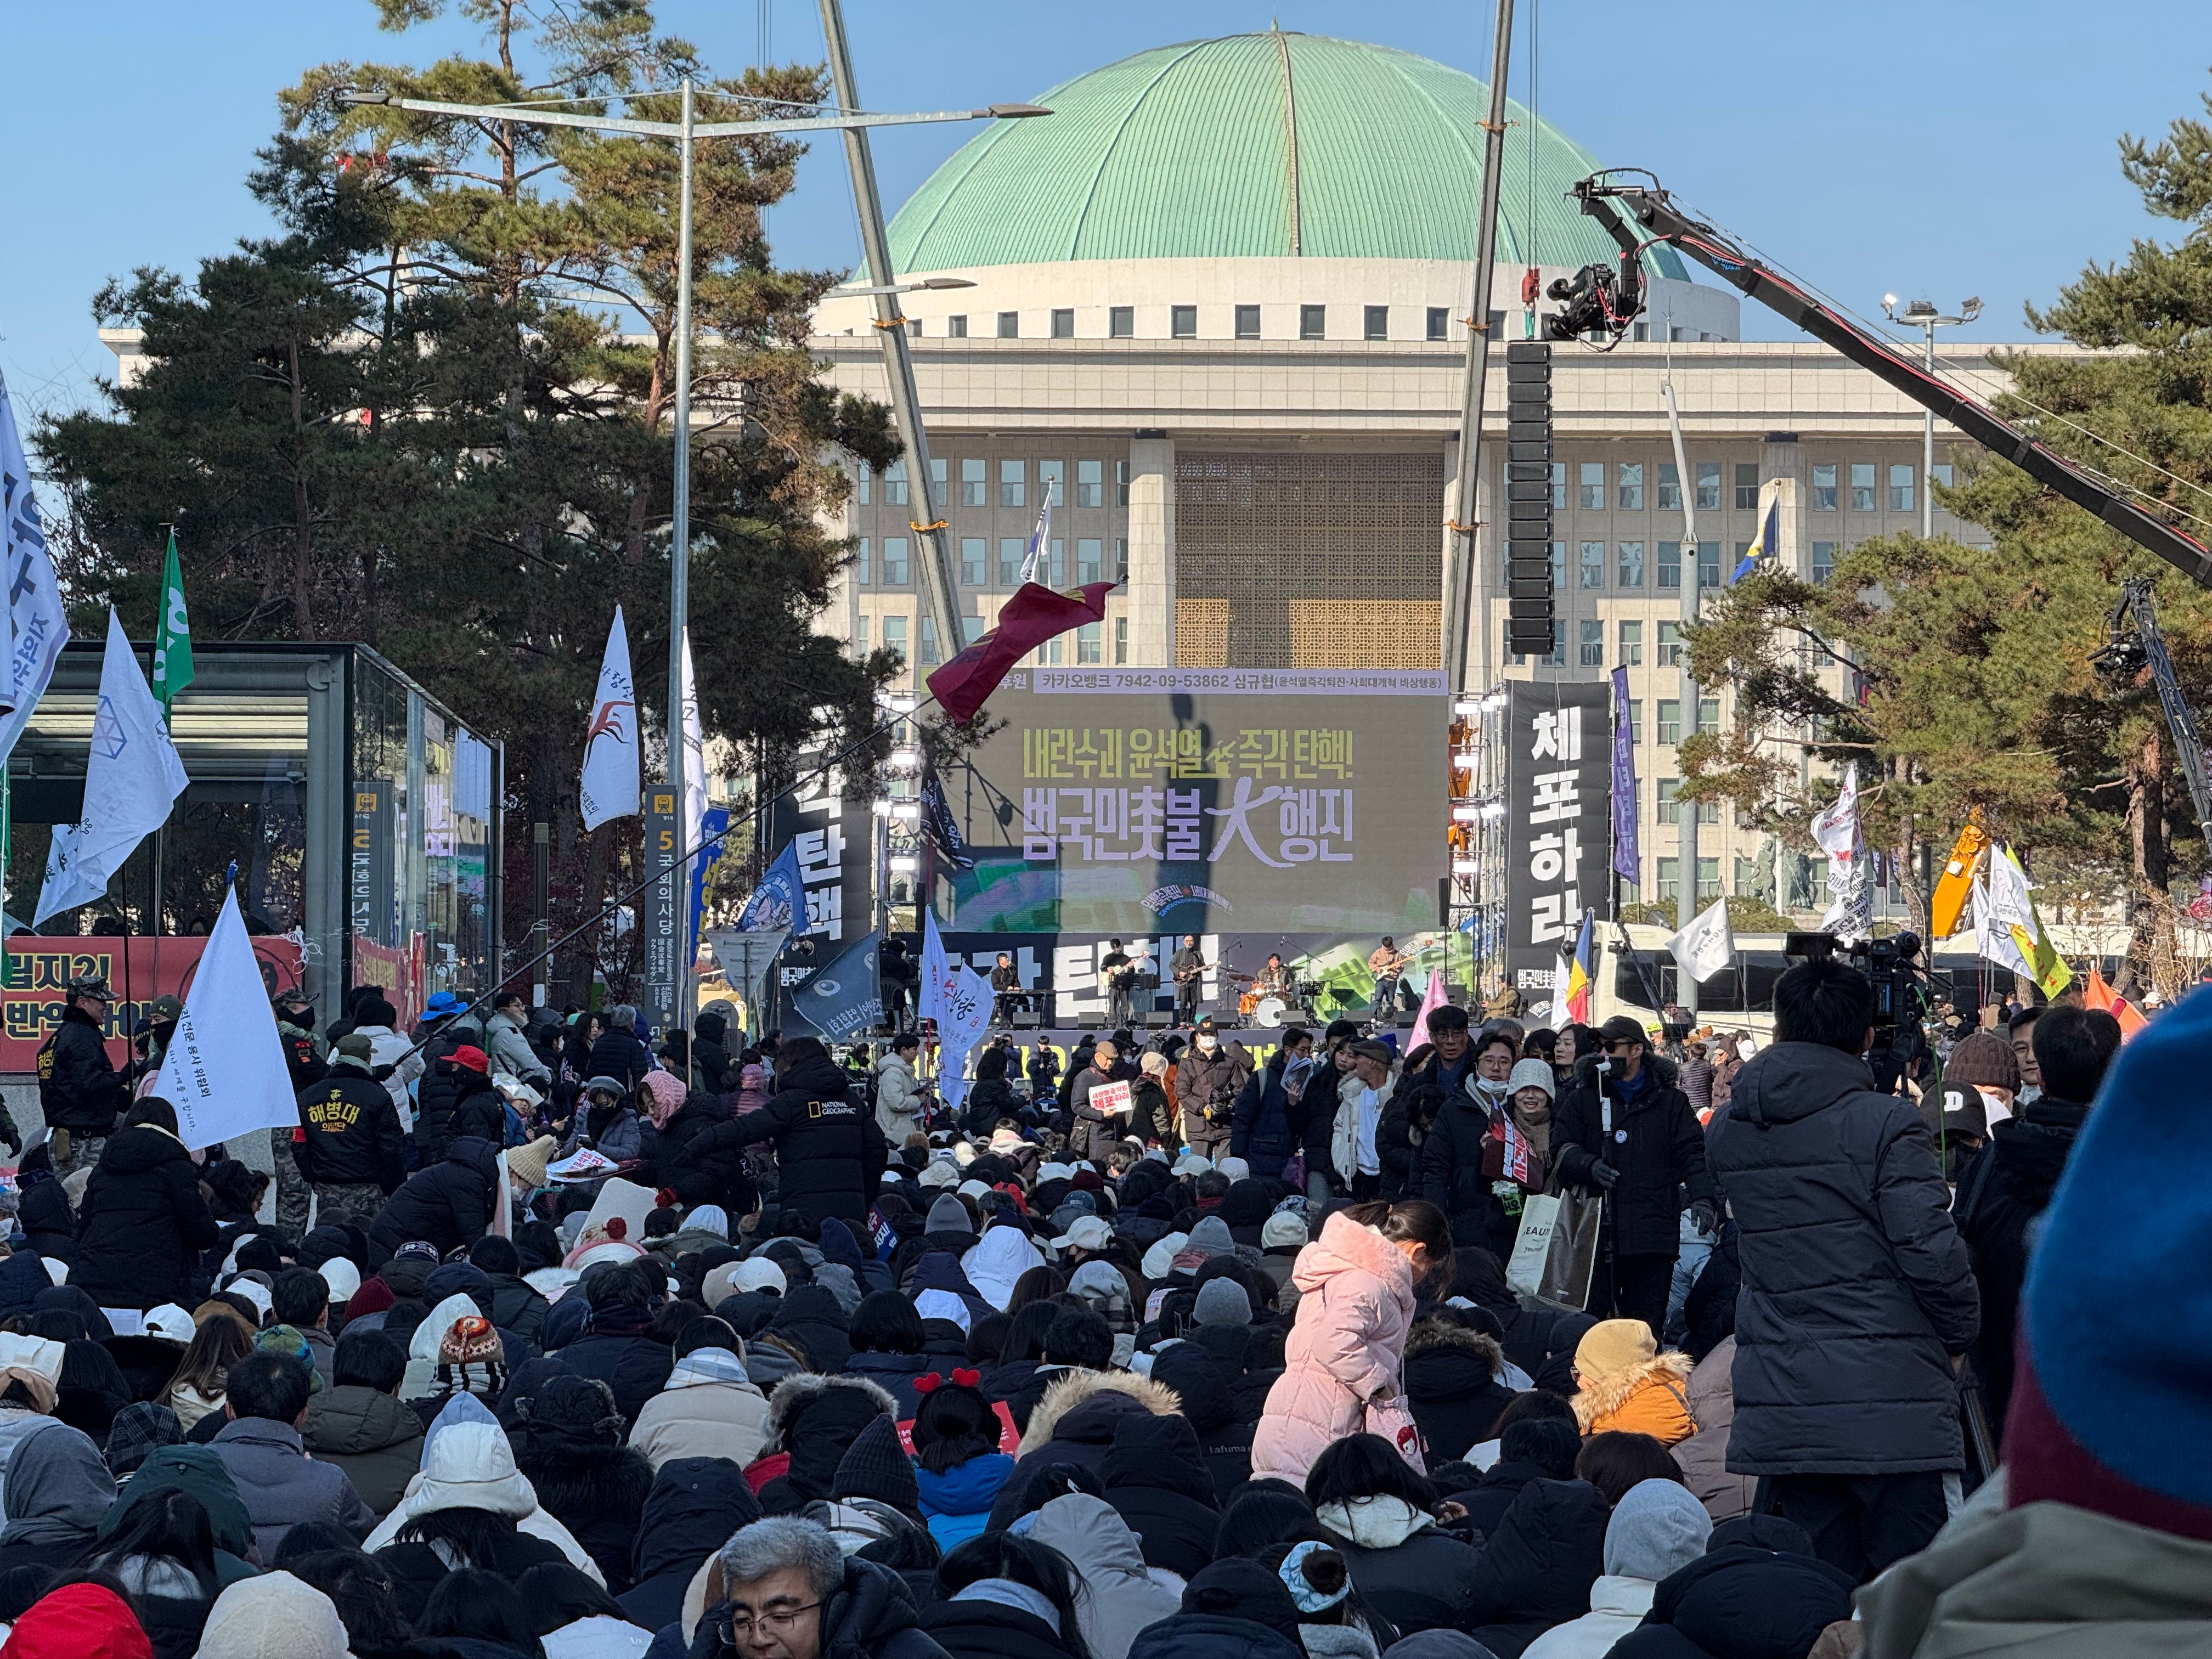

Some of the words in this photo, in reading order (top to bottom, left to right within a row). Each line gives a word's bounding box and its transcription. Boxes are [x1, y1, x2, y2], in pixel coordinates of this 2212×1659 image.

[1042, 674, 1111, 689] 카카오뱅크
[1116, 675, 1228, 689] 7942-09-53862
[1400, 677, 1442, 690] 비상행동)
[1023, 728, 1122, 778] 내란수괴
[1129, 728, 1202, 779] 윤석열
[1239, 729, 1288, 780] 즉각
[1294, 728, 1353, 780] 탄핵!
[1530, 706, 1583, 944] 체포하라
[659, 831, 673, 850] 5
[658, 854, 674, 935] 국회의사당
[182, 1021, 195, 1041] 전문
[188, 1045, 202, 1065] 용사
[194, 1068, 212, 1098] 위원회
[1944, 1092, 1963, 1111] D
[308, 1102, 360, 1124] 해병대
[1209, 1445, 1246, 1455] Lafuma
